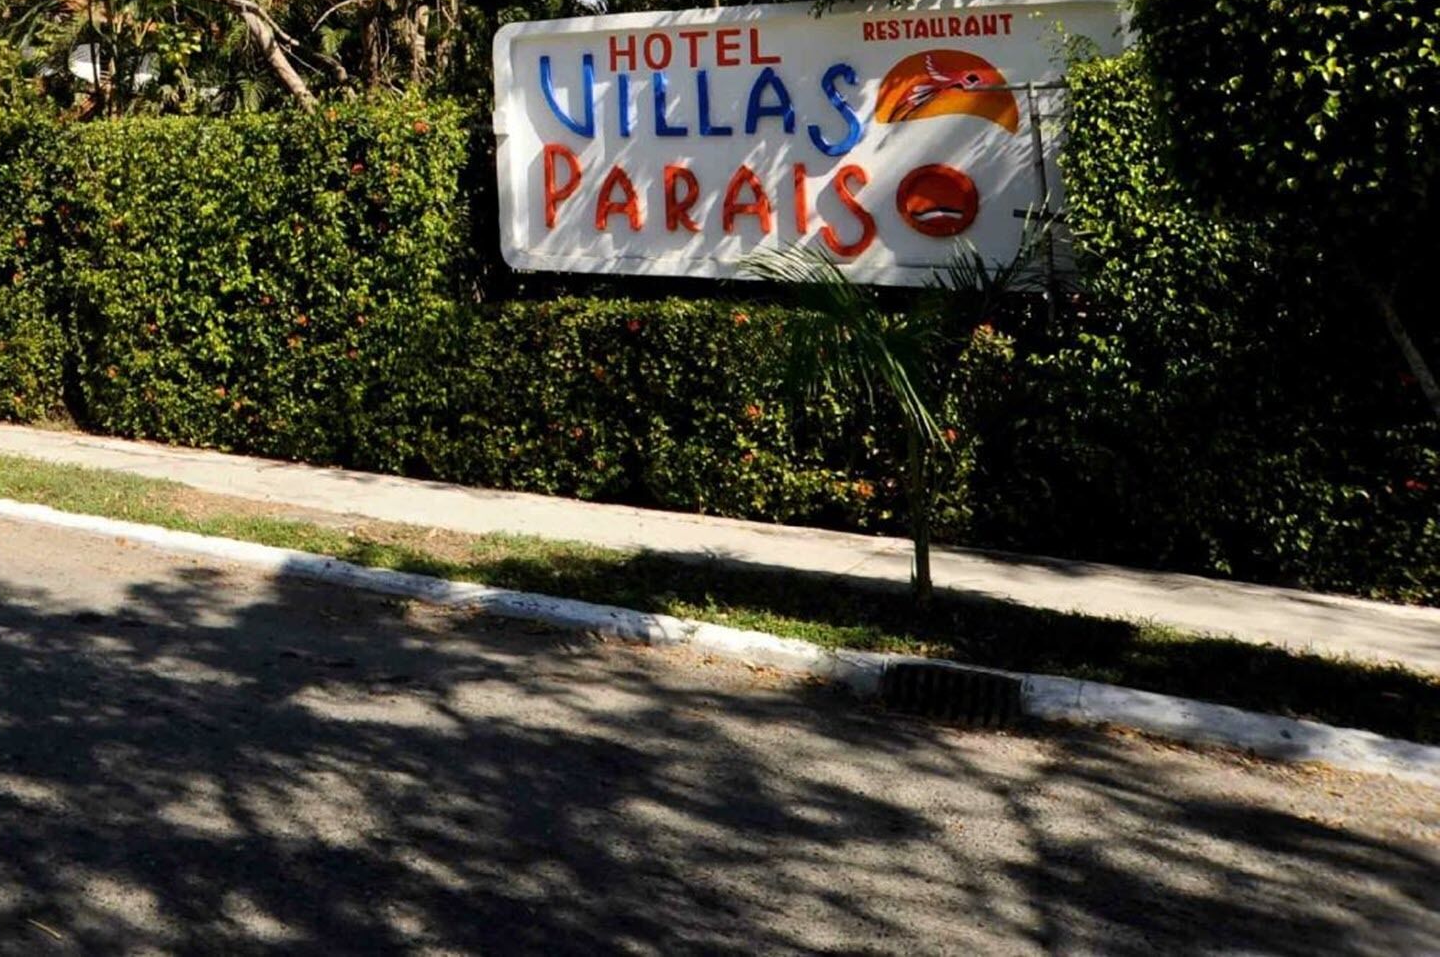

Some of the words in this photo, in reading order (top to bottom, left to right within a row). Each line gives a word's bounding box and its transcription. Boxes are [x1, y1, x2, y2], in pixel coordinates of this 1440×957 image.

[609, 28, 781, 71] HOTEL
[863, 13, 1014, 41] RESTAURANT
[540, 53, 862, 157] VILLAS
[544, 143, 979, 257] PARAISO
